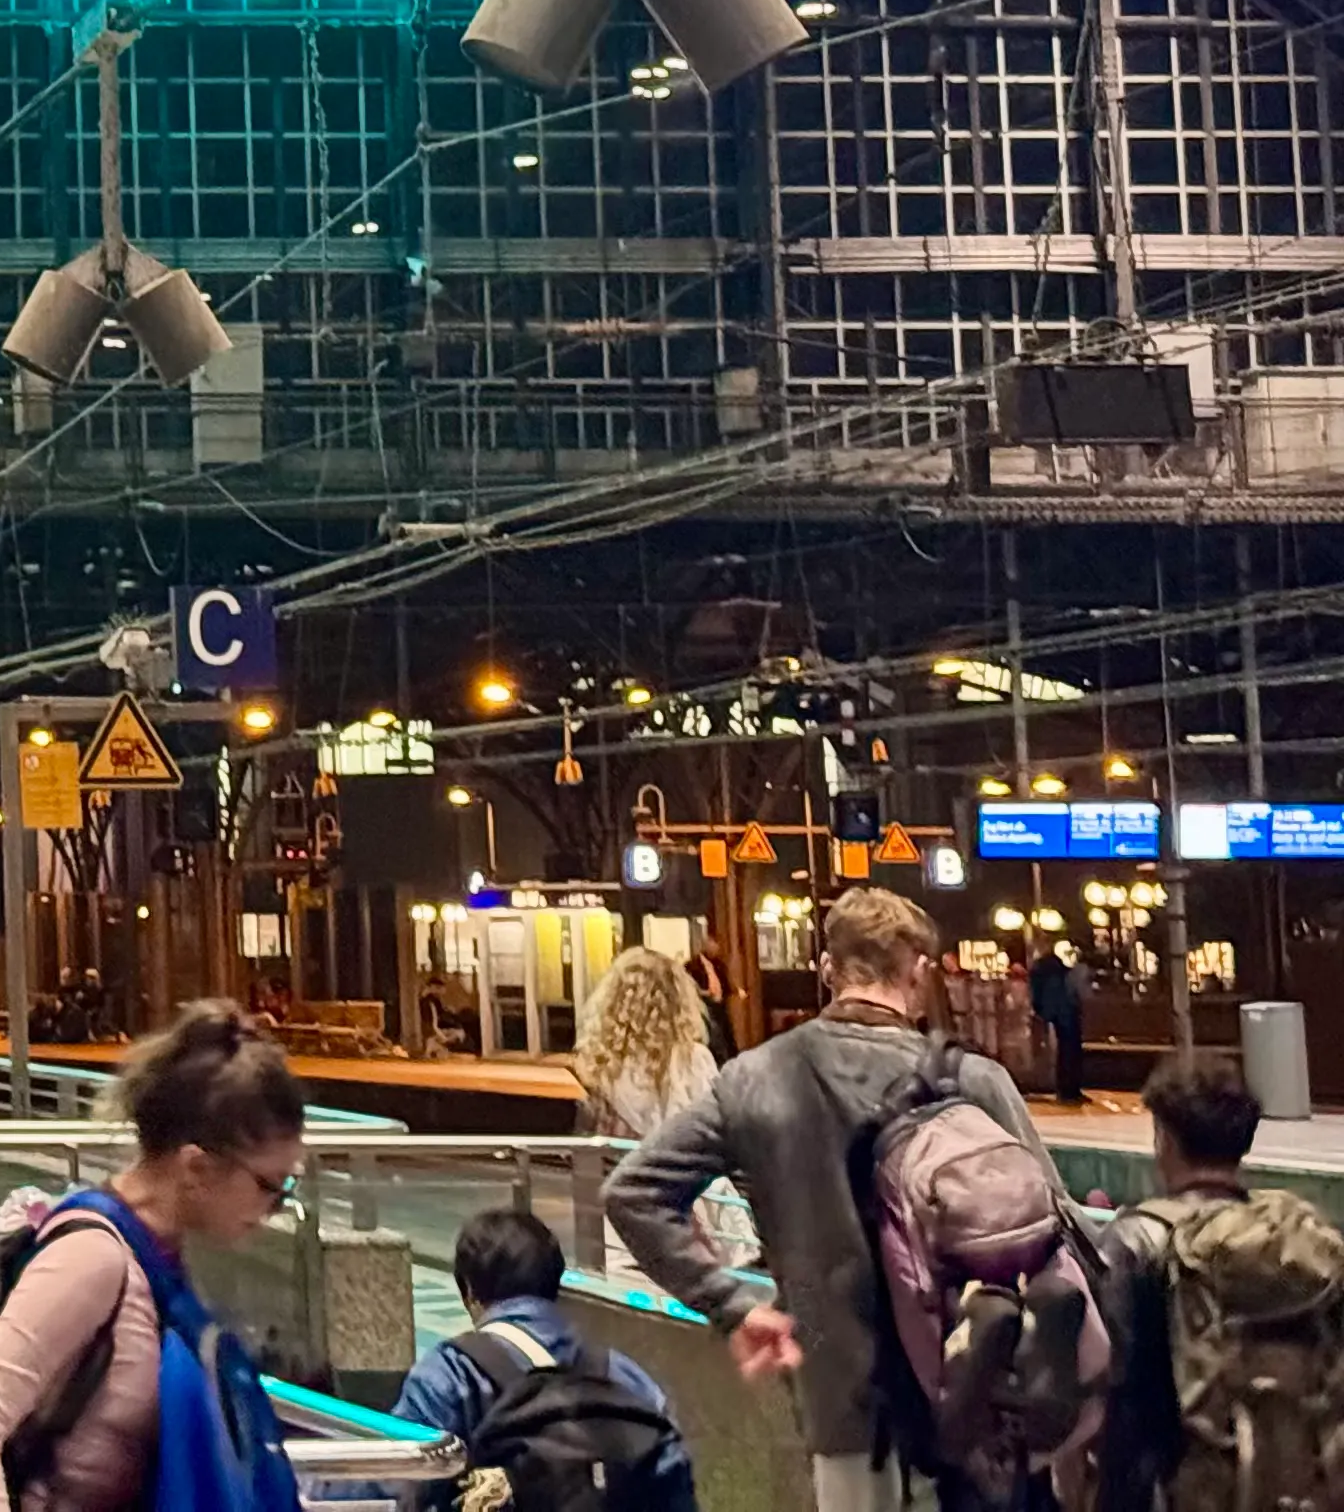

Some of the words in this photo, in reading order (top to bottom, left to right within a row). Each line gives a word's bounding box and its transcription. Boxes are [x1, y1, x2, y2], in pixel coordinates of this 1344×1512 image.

[188, 589, 244, 666] C
[632, 844, 661, 884] B
[936, 846, 964, 886] B
